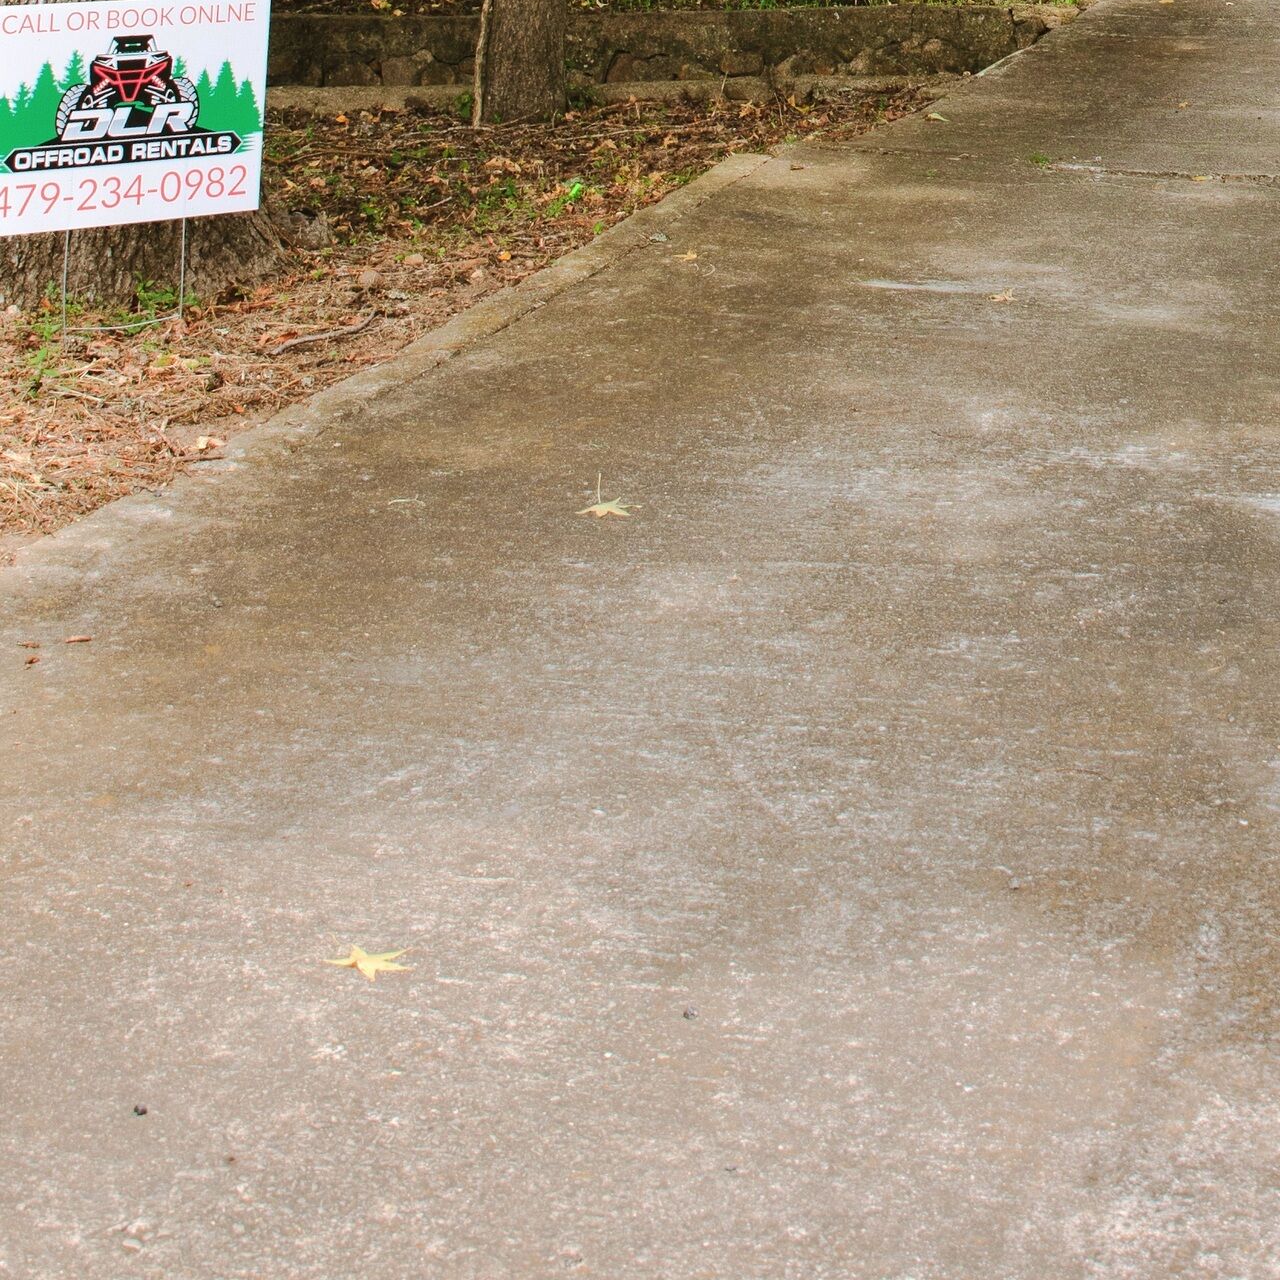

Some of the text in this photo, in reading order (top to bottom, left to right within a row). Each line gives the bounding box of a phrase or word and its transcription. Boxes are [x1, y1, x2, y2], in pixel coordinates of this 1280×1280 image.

[2, 2, 256, 35] CALL OR BOOK ONLNE
[61, 103, 196, 141] DLR
[14, 135, 233, 171] OFFROAD RENTALS
